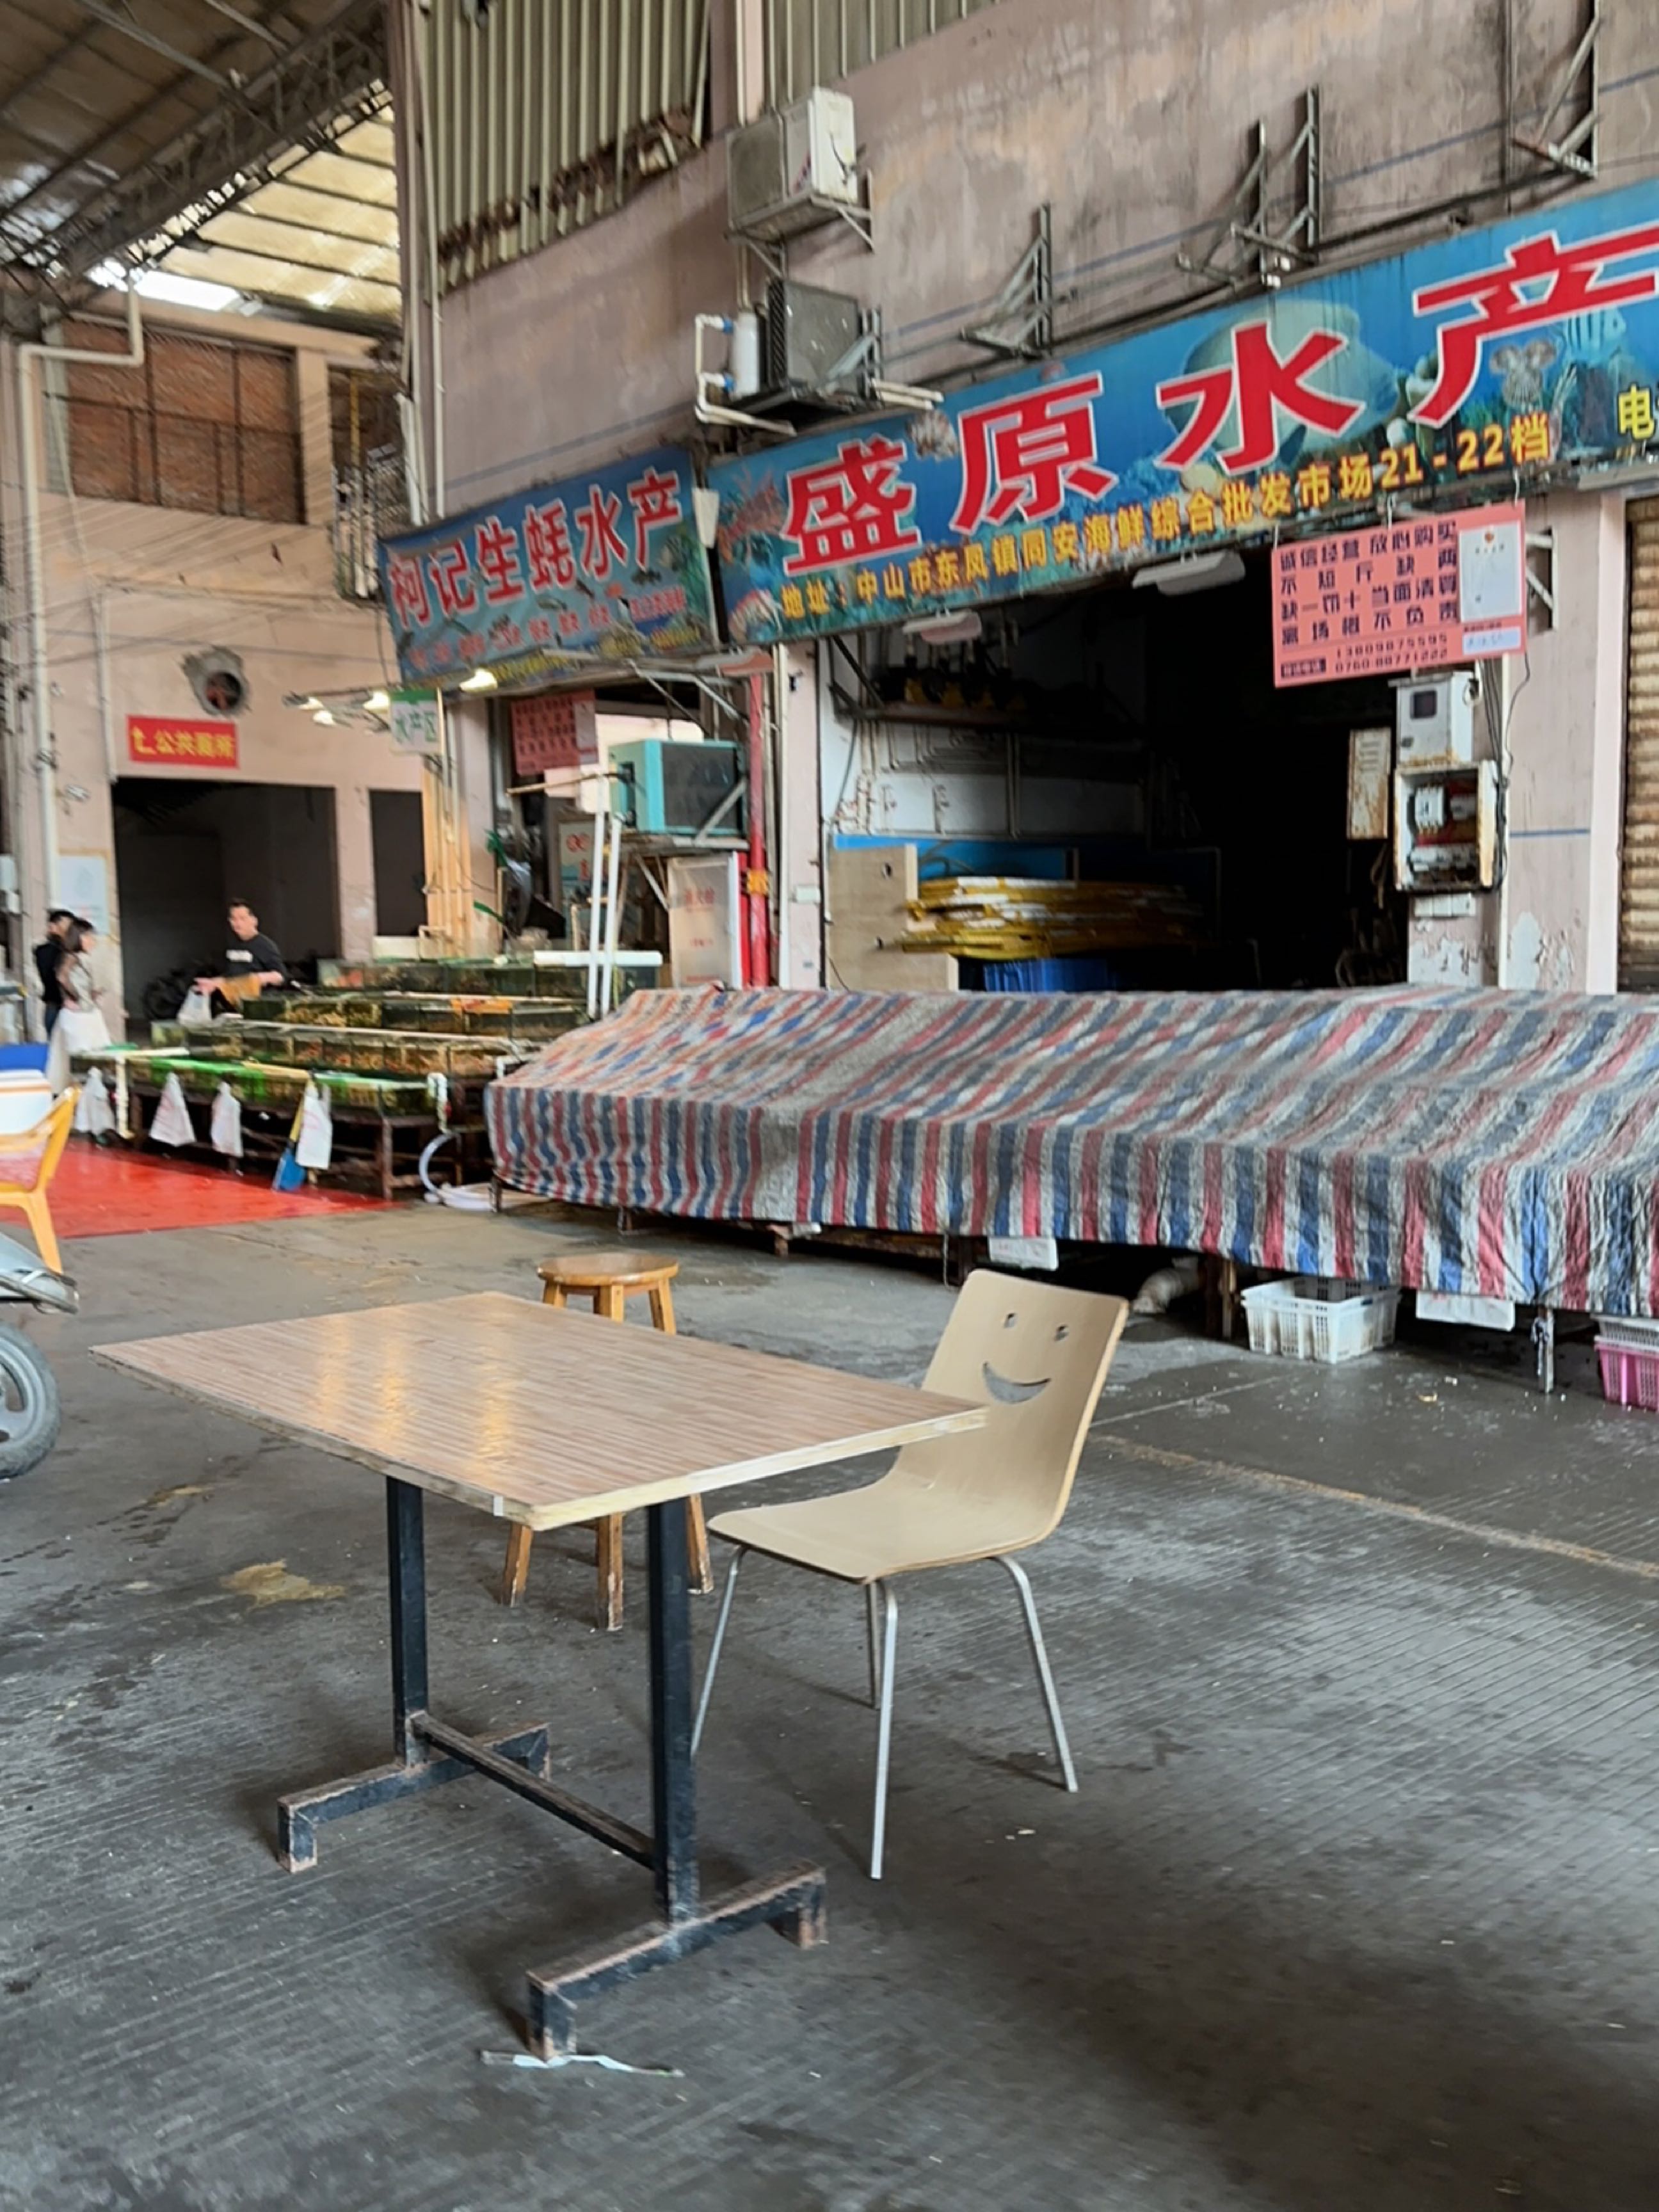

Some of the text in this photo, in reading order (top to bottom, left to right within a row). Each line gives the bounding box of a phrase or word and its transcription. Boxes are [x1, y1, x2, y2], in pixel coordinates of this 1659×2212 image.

[780, 221, 1659, 575] 盛原水产
[1618, 384, 1655, 440] 电
